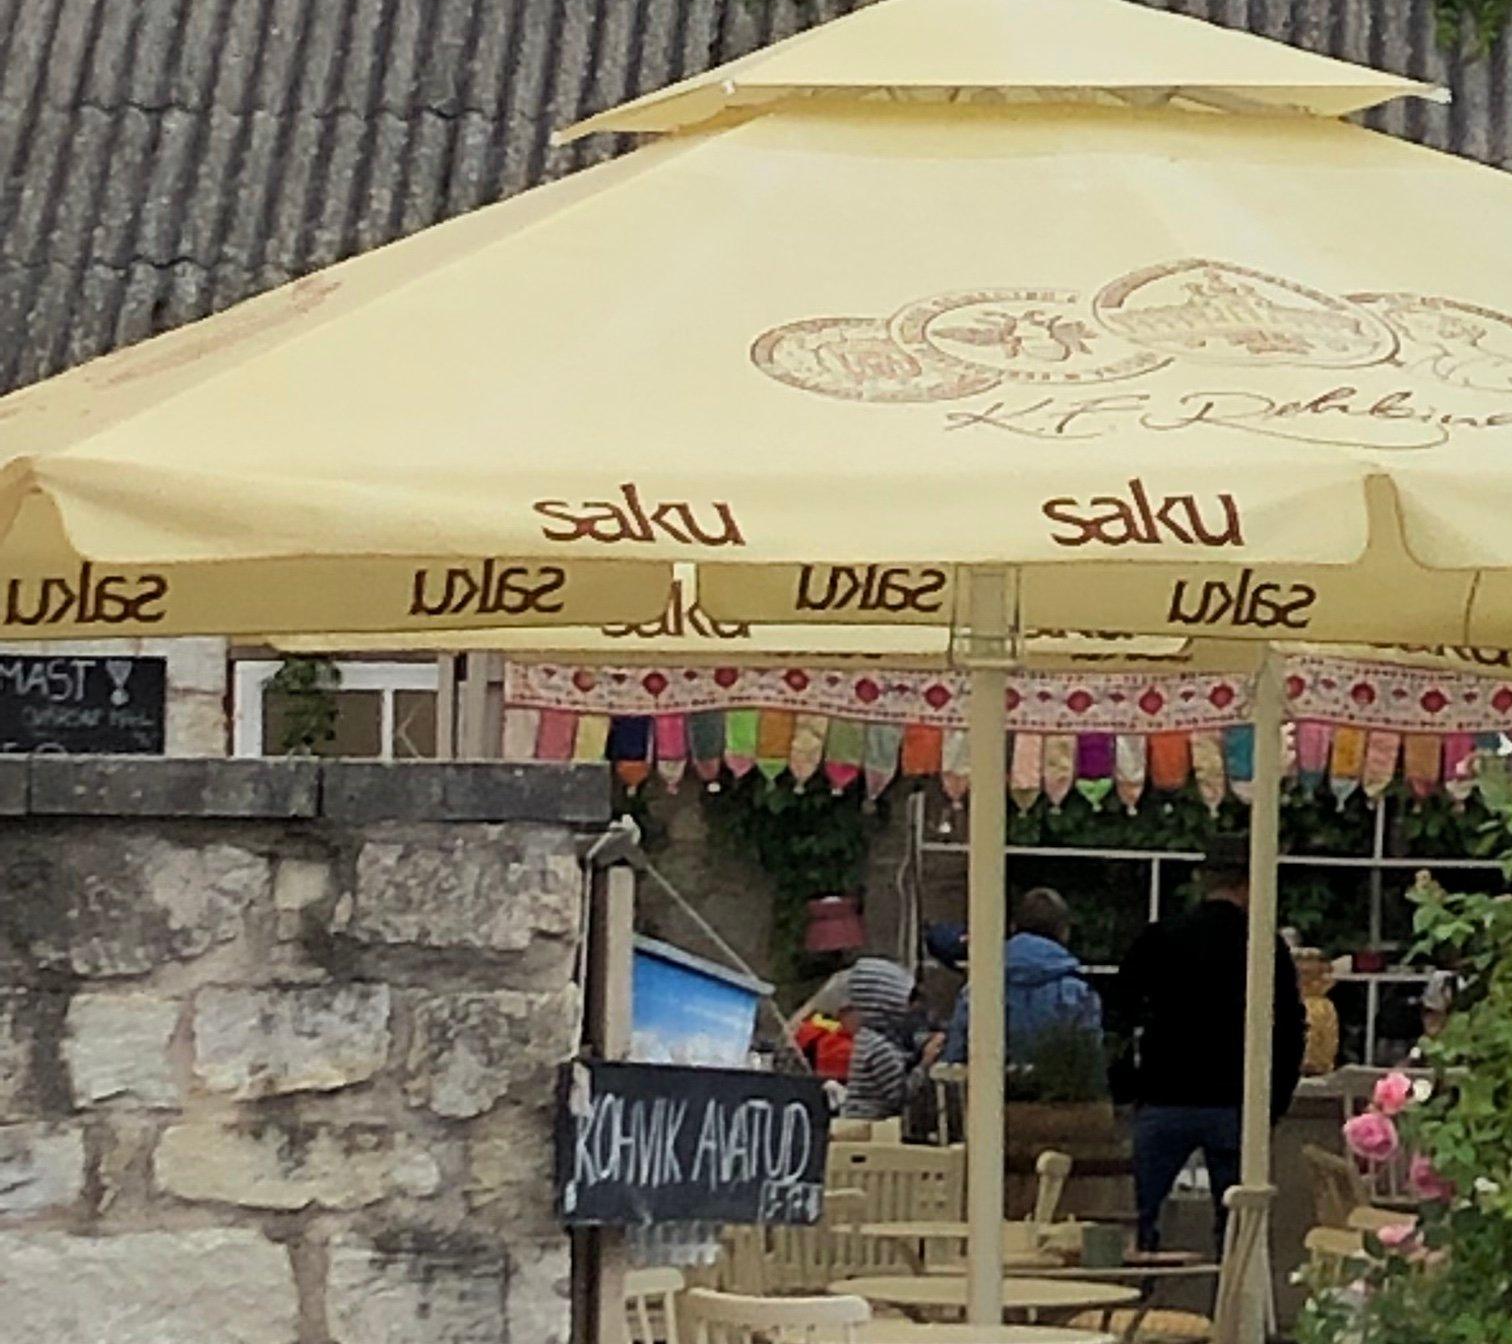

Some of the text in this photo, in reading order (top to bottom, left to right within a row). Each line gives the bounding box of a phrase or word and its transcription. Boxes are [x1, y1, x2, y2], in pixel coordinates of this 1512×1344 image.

[533, 483, 747, 547] saku
[1042, 478, 1245, 547] saku
[573, 1092, 813, 1193] KOHVIK AVATUD
